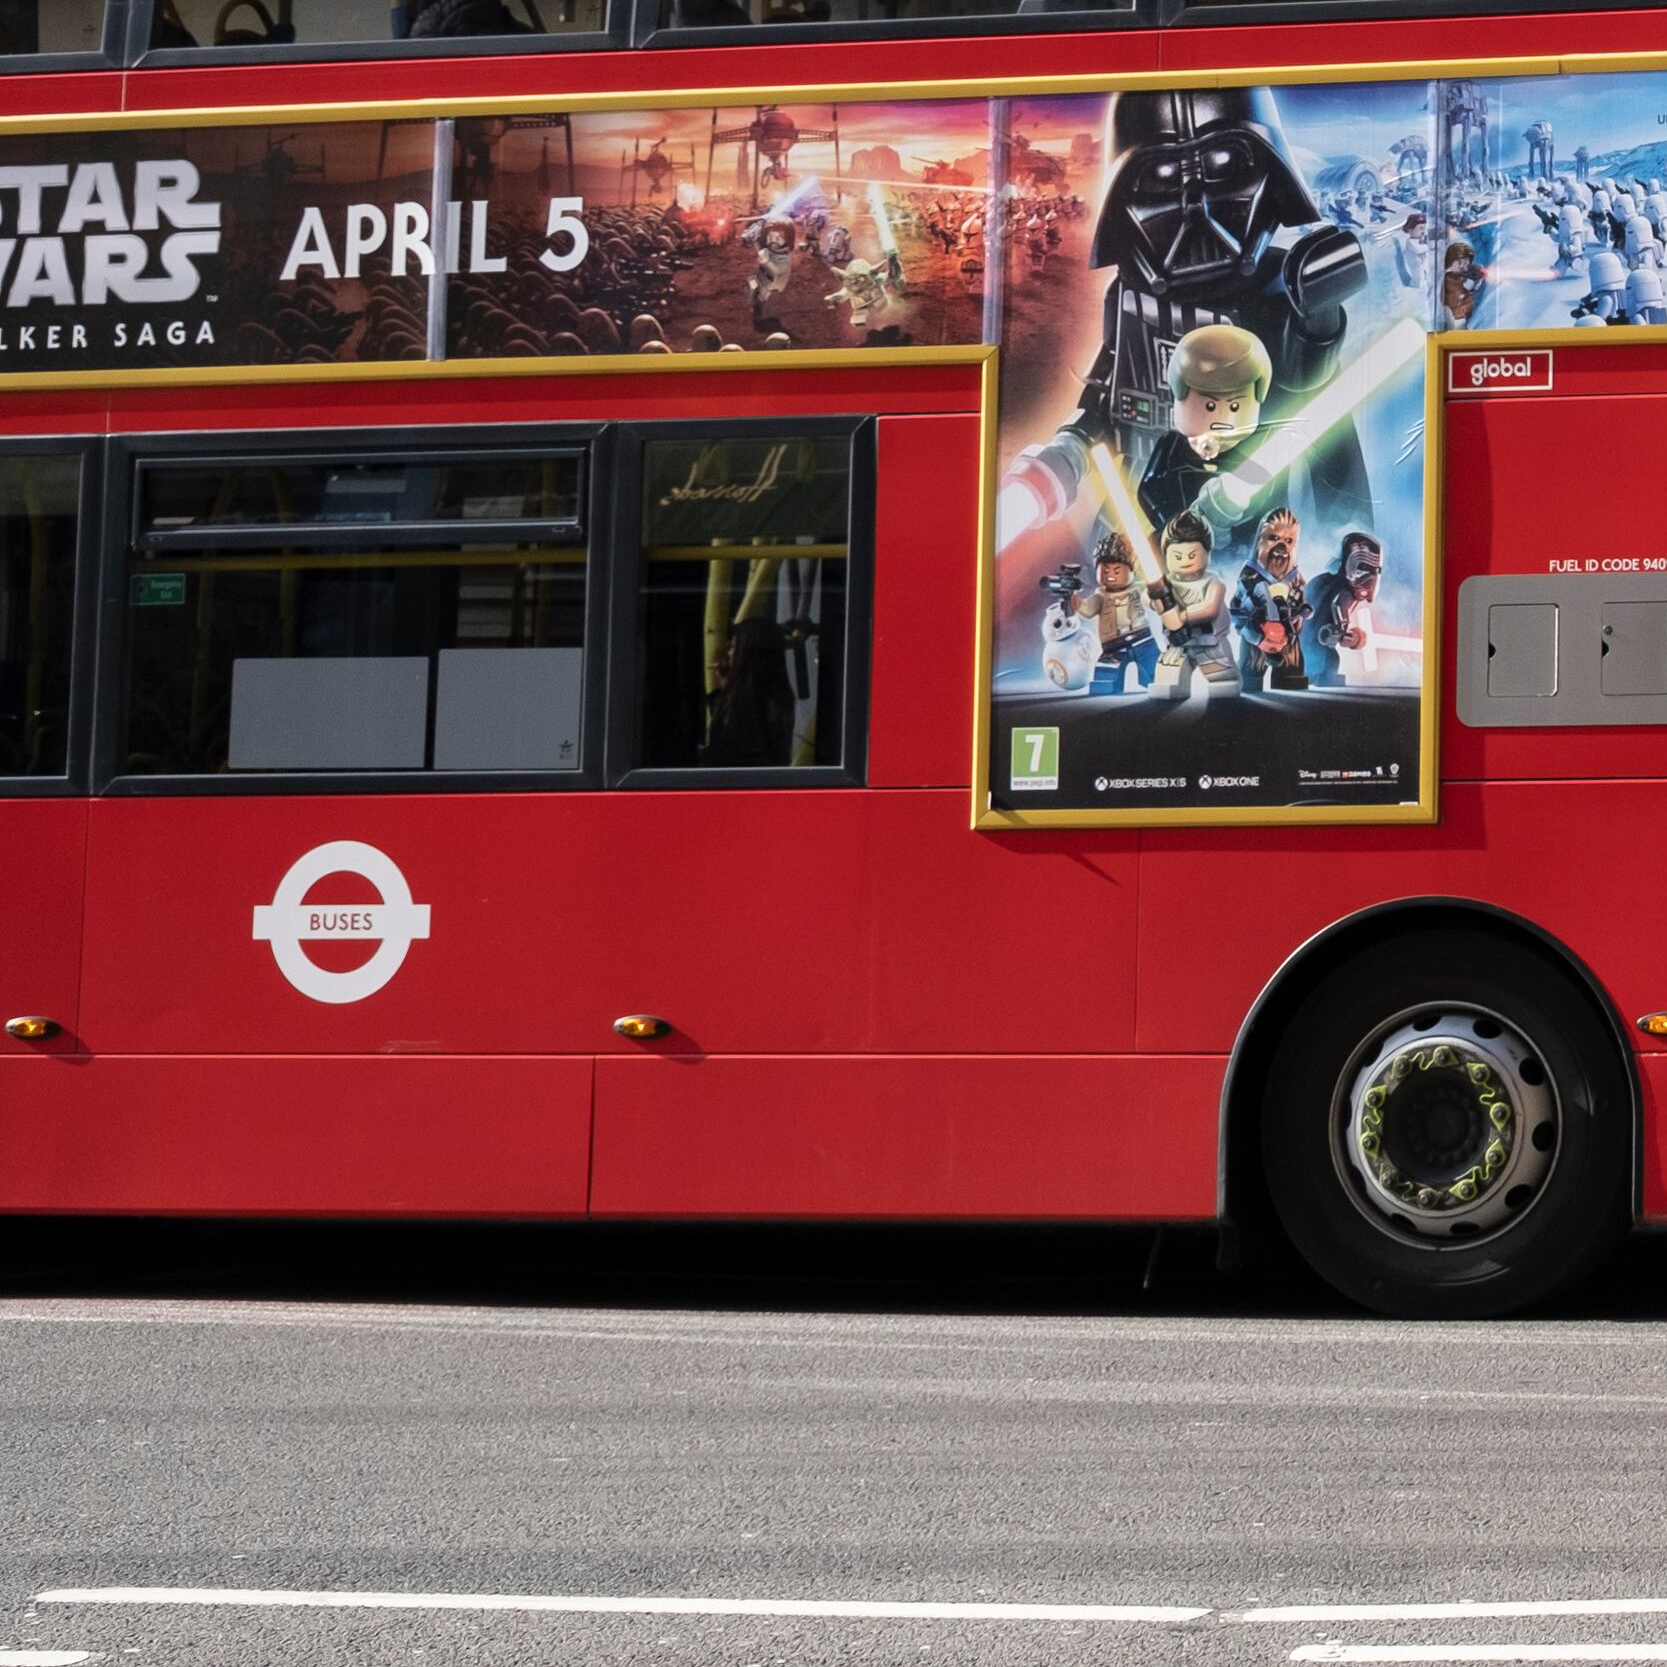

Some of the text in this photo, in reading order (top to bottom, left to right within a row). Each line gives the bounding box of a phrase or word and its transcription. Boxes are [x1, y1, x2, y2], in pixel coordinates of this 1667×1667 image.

[0, 159, 221, 234] TAR
[279, 196, 589, 281] APRIL 5
[0, 231, 221, 308] ARS
[113, 320, 215, 348] SAGA
[1470, 356, 1532, 386] global
[1549, 559, 1582, 572] FUEL
[1585, 559, 1599, 572] ID
[1601, 558, 1640, 571] CODE
[1025, 734, 1045, 772] 7
[1108, 779, 1135, 788] XBOX
[1136, 778, 1167, 788] SERIES
[1212, 776, 1260, 787] XBOX ONE
[310, 913, 373, 931] BUSES
